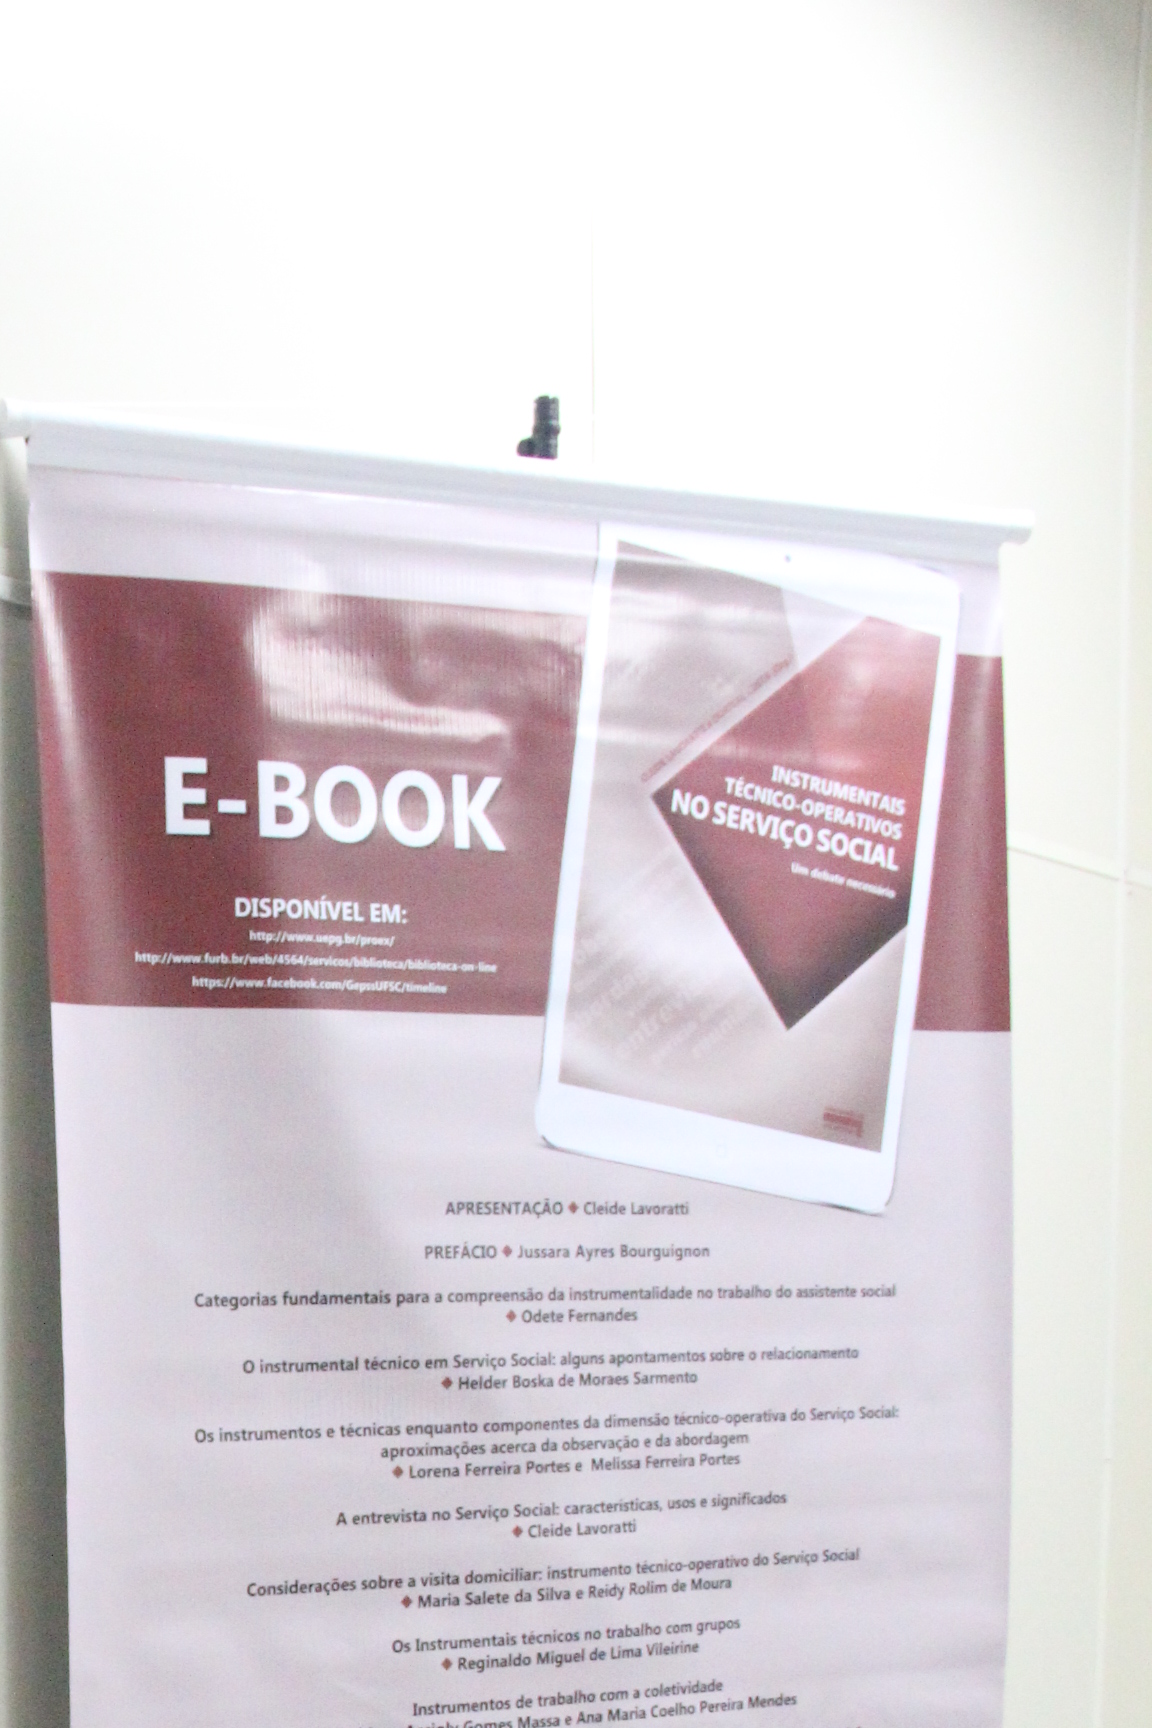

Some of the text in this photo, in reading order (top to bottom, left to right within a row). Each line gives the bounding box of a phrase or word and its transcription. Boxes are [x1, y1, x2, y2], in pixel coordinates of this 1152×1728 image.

[164, 756, 506, 851] E-BOOK
[771, 764, 906, 816] INSTRUMENTAIS
[724, 776, 903, 840] TÉCNICO-OPERATIVOS
[670, 788, 900, 872] NO SERVIÇO SOCIAL
[791, 861, 896, 899] Um debate necessário
[234, 895, 409, 925] DISPONÍVEL EM:
[249, 930, 395, 947] http://www.uepg.br/proex/
[444, 1198, 690, 1218] APRESENTAÇÃO Cleide Lavoratti
[423, 1241, 710, 1261] PREFÁCIO Jussara Ayres Bourguignon
[193, 1283, 896, 1309] Categorias fundamentais para a compreensão da instrumentalidade no trabalho do assistente social
[241, 1346, 860, 1373] O instrumental técnico em Serviço Social: alguns apontamentos sobre o relacionamento
[245, 1548, 860, 1596] Considerações sobre a visita domiciliar: instrumento técnico-operativo do Serviço Social
